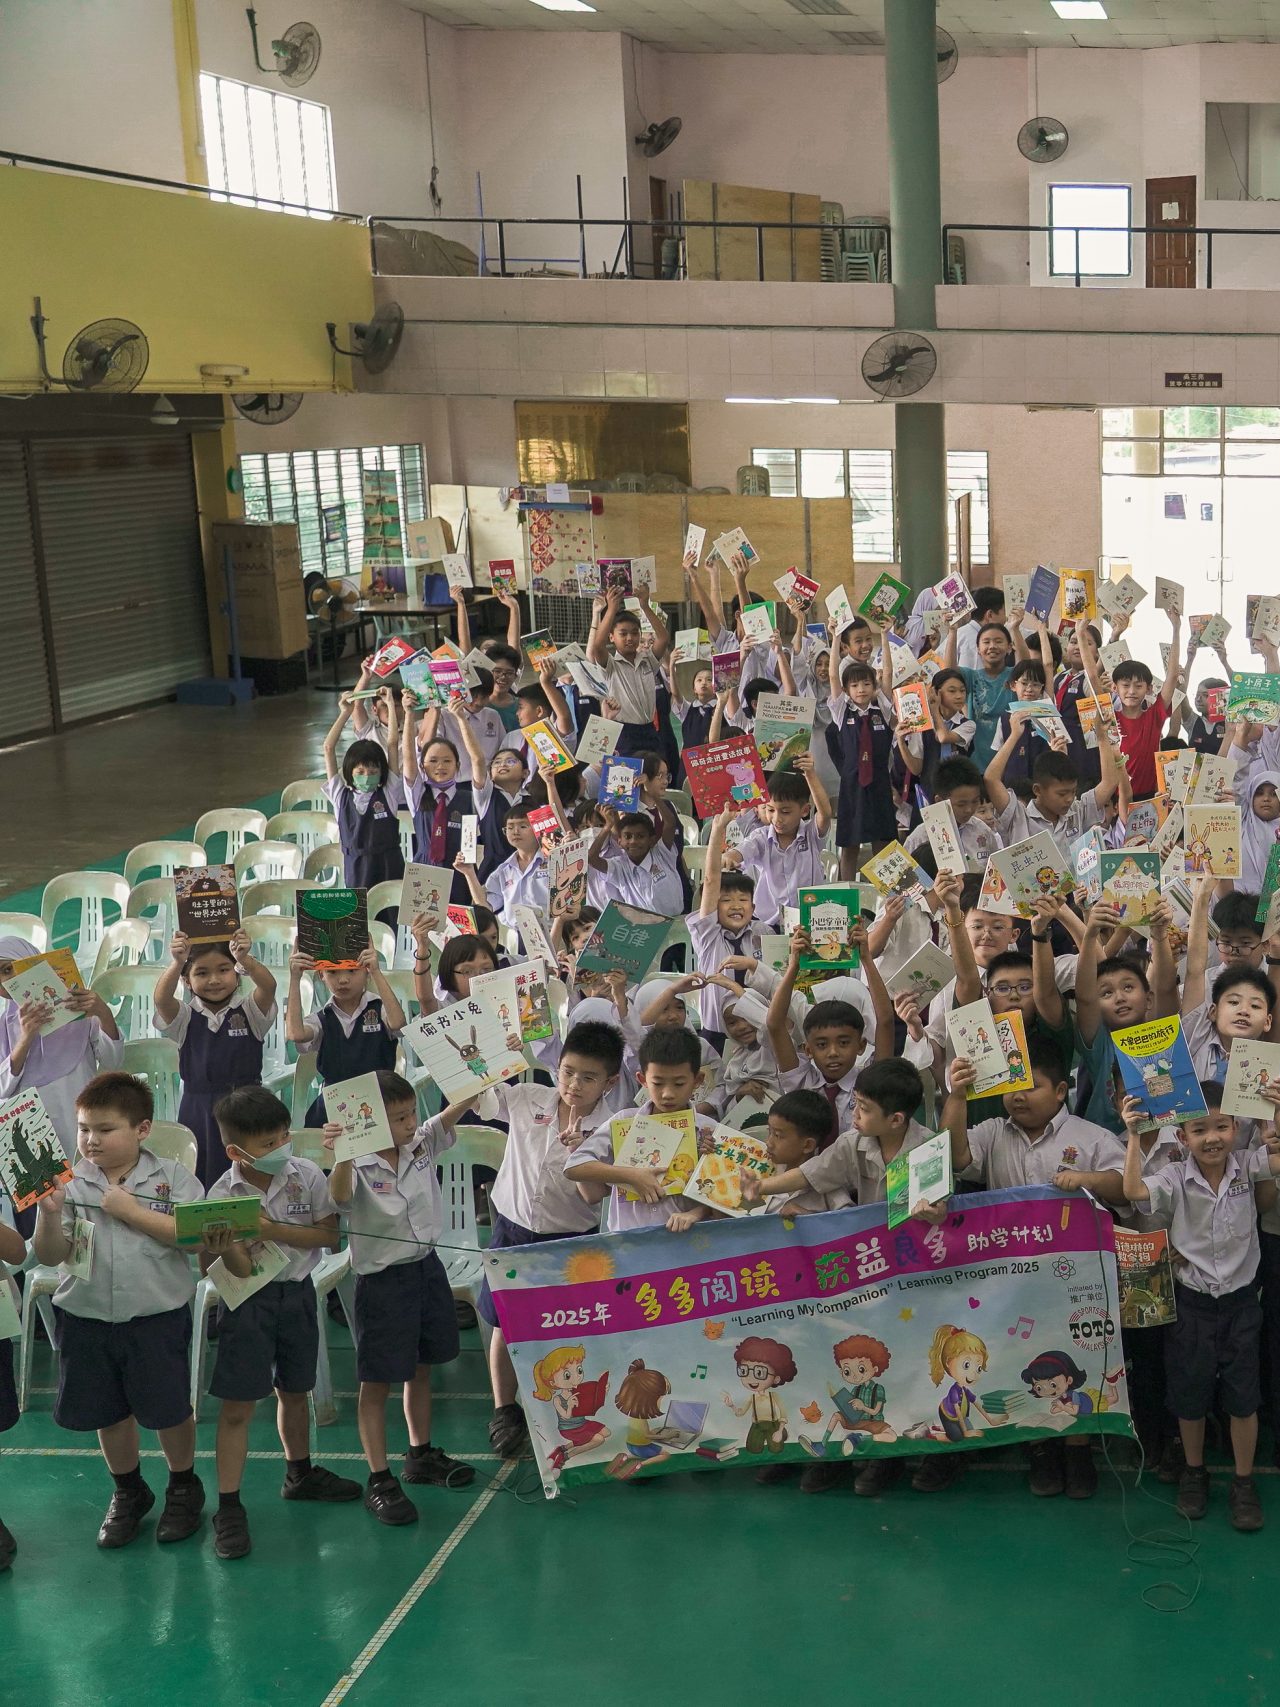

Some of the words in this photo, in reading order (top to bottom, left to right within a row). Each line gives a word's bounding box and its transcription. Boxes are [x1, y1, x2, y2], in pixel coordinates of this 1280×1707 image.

[1244, 678, 1272, 688] 小房子
[690, 748, 751, 768] 佩奇走进童话故事
[1010, 850, 1047, 874] 昆虫记
[192, 898, 227, 908] 肚子里的
[810, 916, 850, 926] 小巴掌童话
[612, 924, 650, 948] 自律
[516, 970, 538, 986] 猴王
[420, 1000, 482, 1037] 偷书小兔
[1118, 1024, 1174, 1047] 大象巴巴的旅行
[967, 1224, 1053, 1252] 助学计划
[731, 1304, 794, 1328] “Learning
[797, 1302, 815, 1318] My
[816, 1282, 895, 1315] Companion”
[898, 1273, 953, 1292] Learning
[954, 1263, 1009, 1285] Program
[1010, 1261, 1040, 1275] 2025
[1070, 1292, 1105, 1304] 推广单位
[541, 1302, 612, 1328] 2025年
[1077, 1306, 1100, 1317] SPORTS
[1069, 1319, 1115, 1340] TOTO
